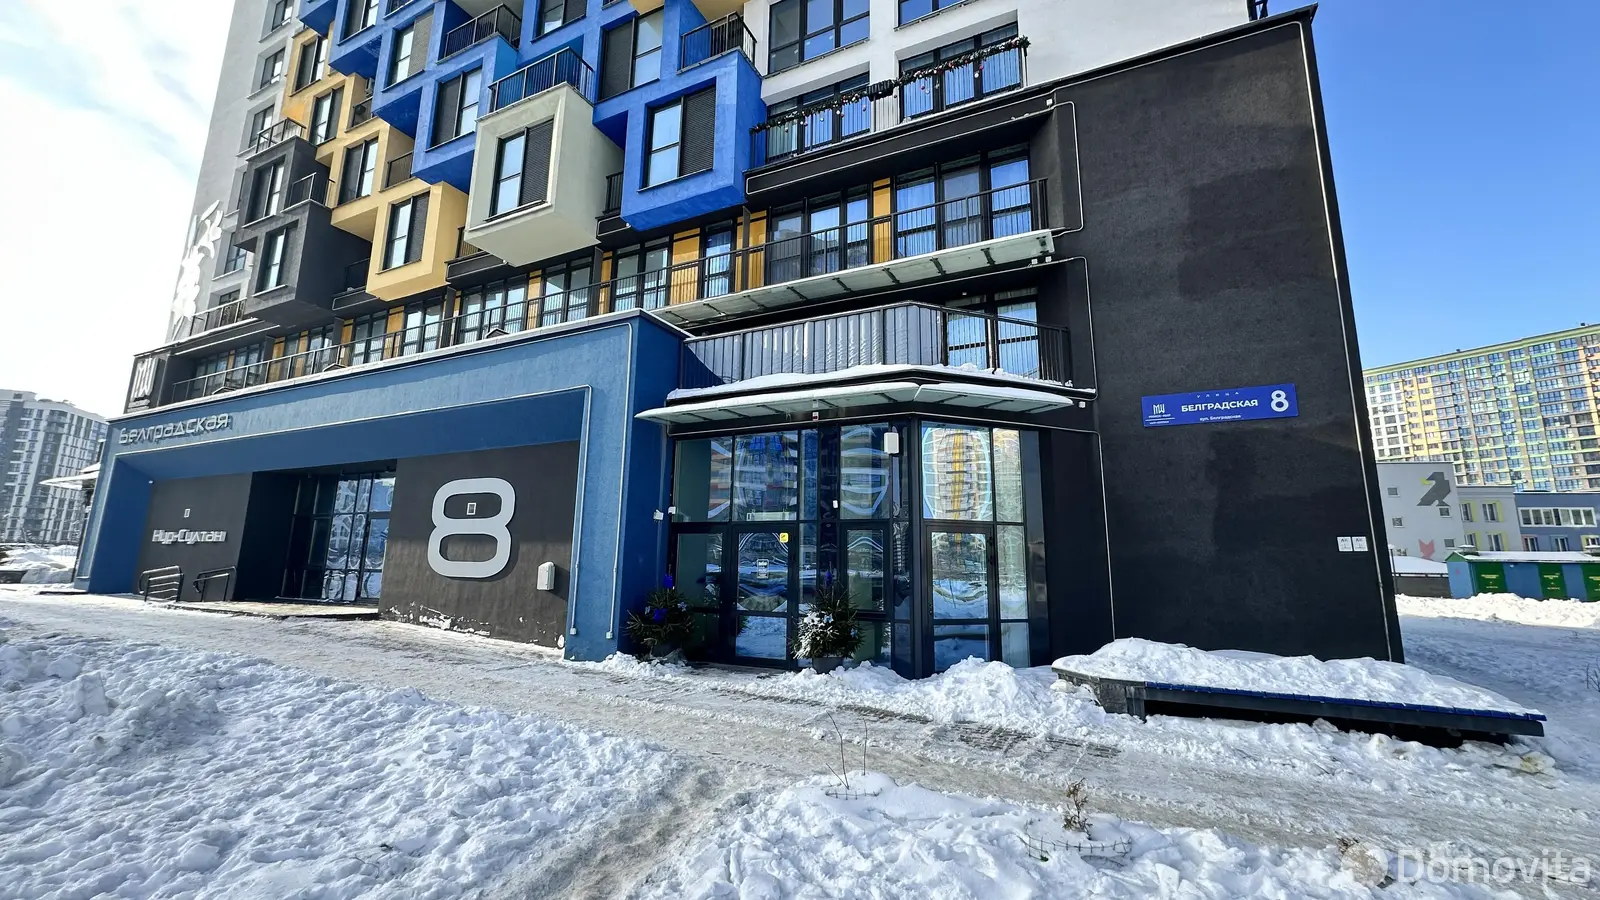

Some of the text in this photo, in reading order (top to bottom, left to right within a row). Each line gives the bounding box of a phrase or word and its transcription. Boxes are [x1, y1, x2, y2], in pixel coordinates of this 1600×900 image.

[1181, 399, 1259, 412] БЕЛГРАДСКАЯ
[1270, 389, 1289, 412] 8
[119, 413, 229, 444] Белградская
[151, 528, 227, 545] Нур-Султан
[427, 477, 516, 579] 8
